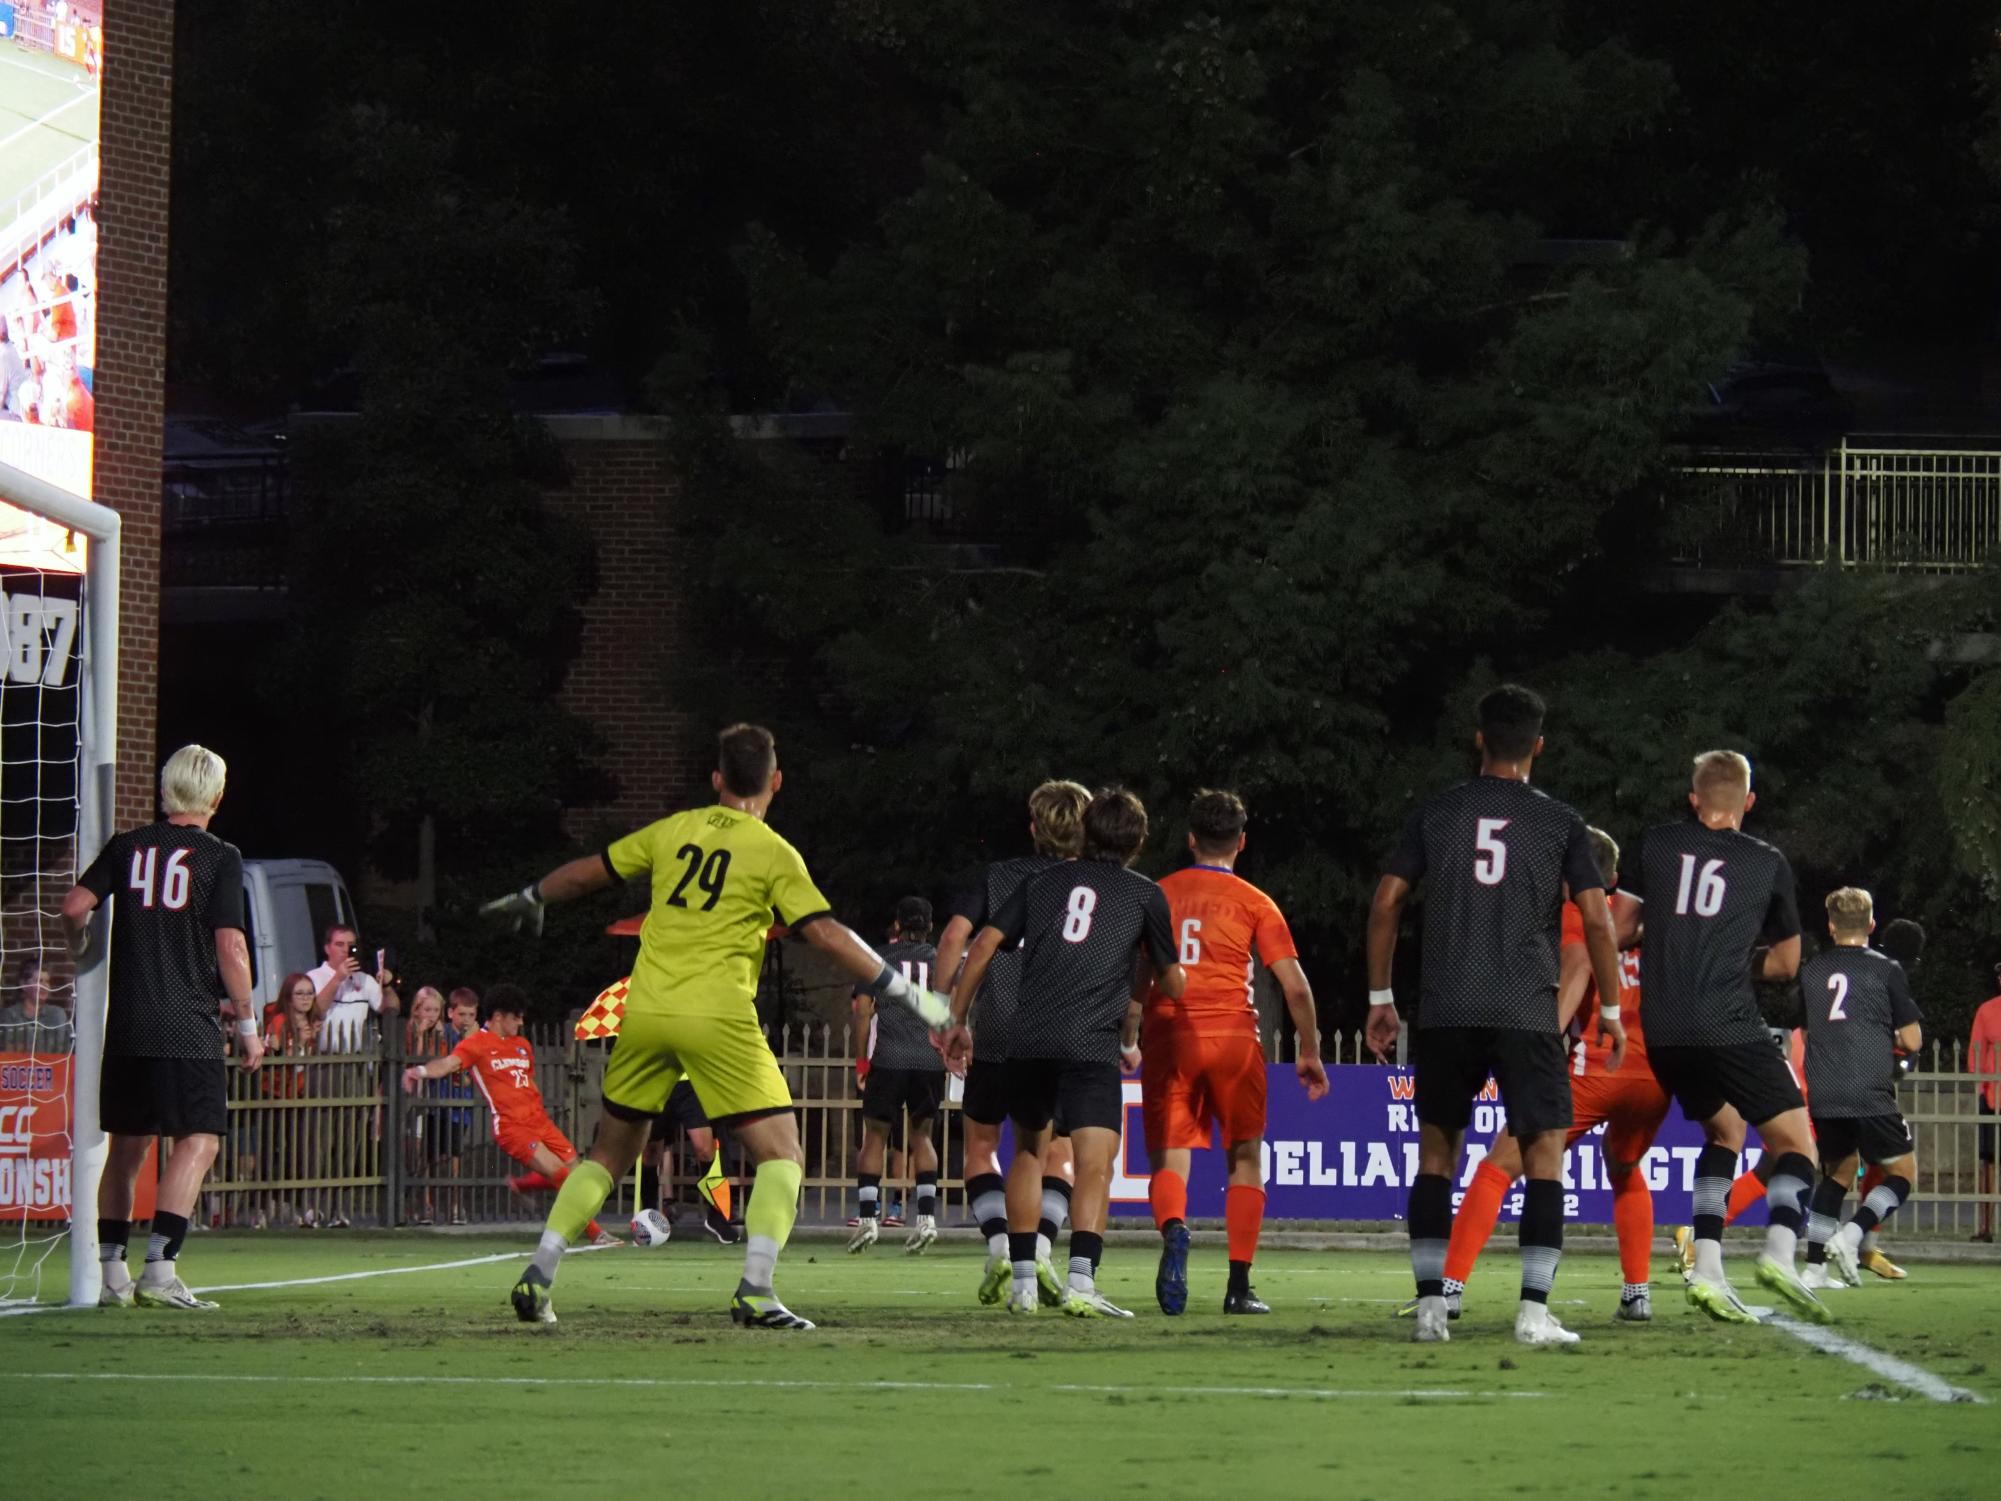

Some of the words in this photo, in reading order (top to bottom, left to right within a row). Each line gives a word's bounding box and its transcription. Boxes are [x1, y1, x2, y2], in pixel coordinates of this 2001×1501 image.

[129, 846, 191, 910] 46
[665, 842, 732, 912] 29
[1473, 817, 1510, 885] 5
[1062, 885, 1097, 943] 8
[1676, 853, 1727, 918] 16
[1179, 918, 1202, 965] 6
[1827, 972, 1848, 1021] 2
[2, 1066, 54, 1091] SOCCER
